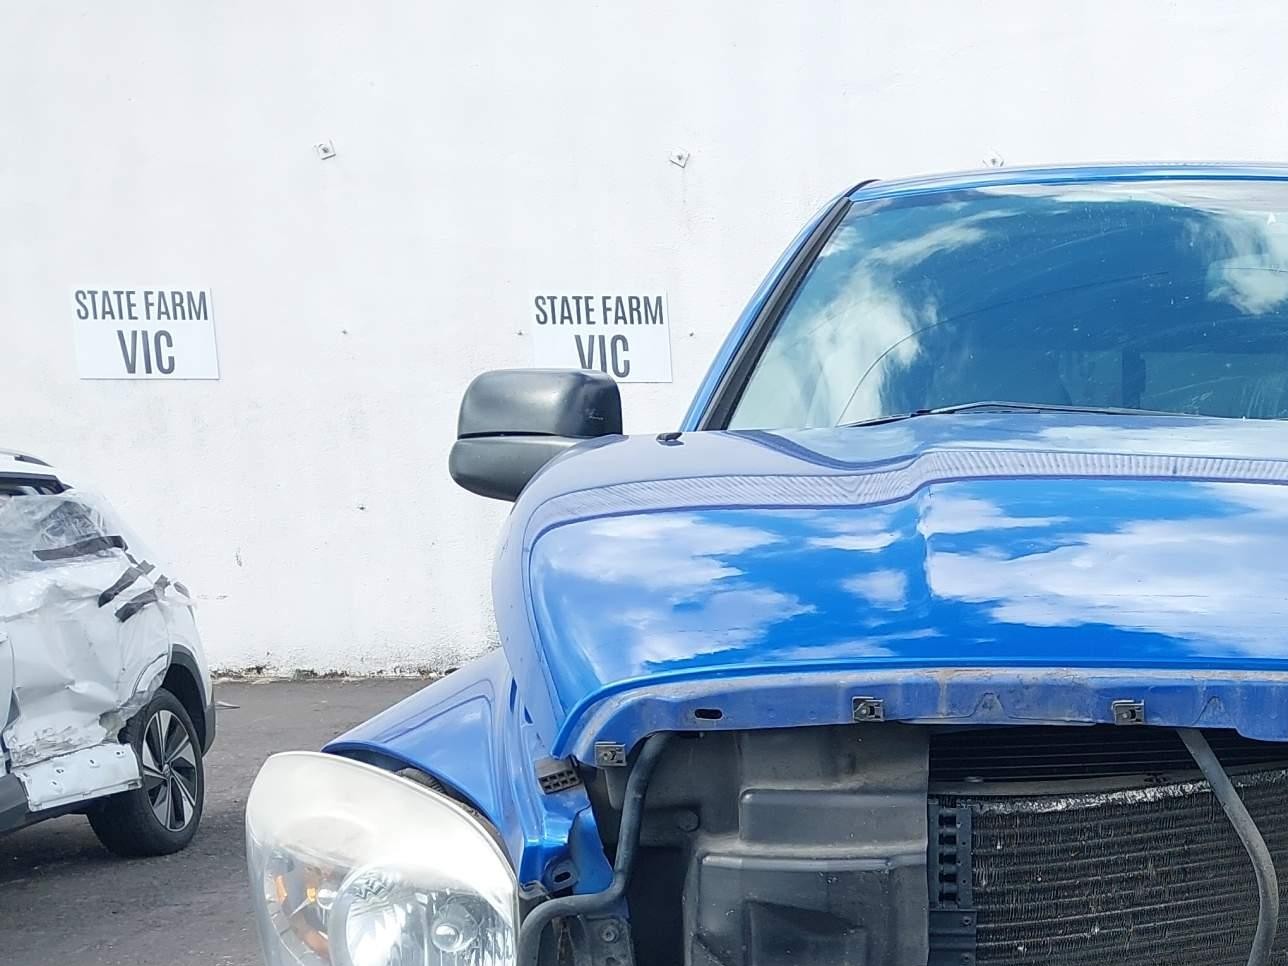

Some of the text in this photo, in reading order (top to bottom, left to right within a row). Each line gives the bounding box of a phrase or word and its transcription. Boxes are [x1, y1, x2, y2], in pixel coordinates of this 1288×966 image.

[74, 290, 208, 321] STATE FARM
[534, 296, 664, 326] STATE FARM
[116, 329, 176, 375] VIC
[574, 334, 631, 378] VIC
